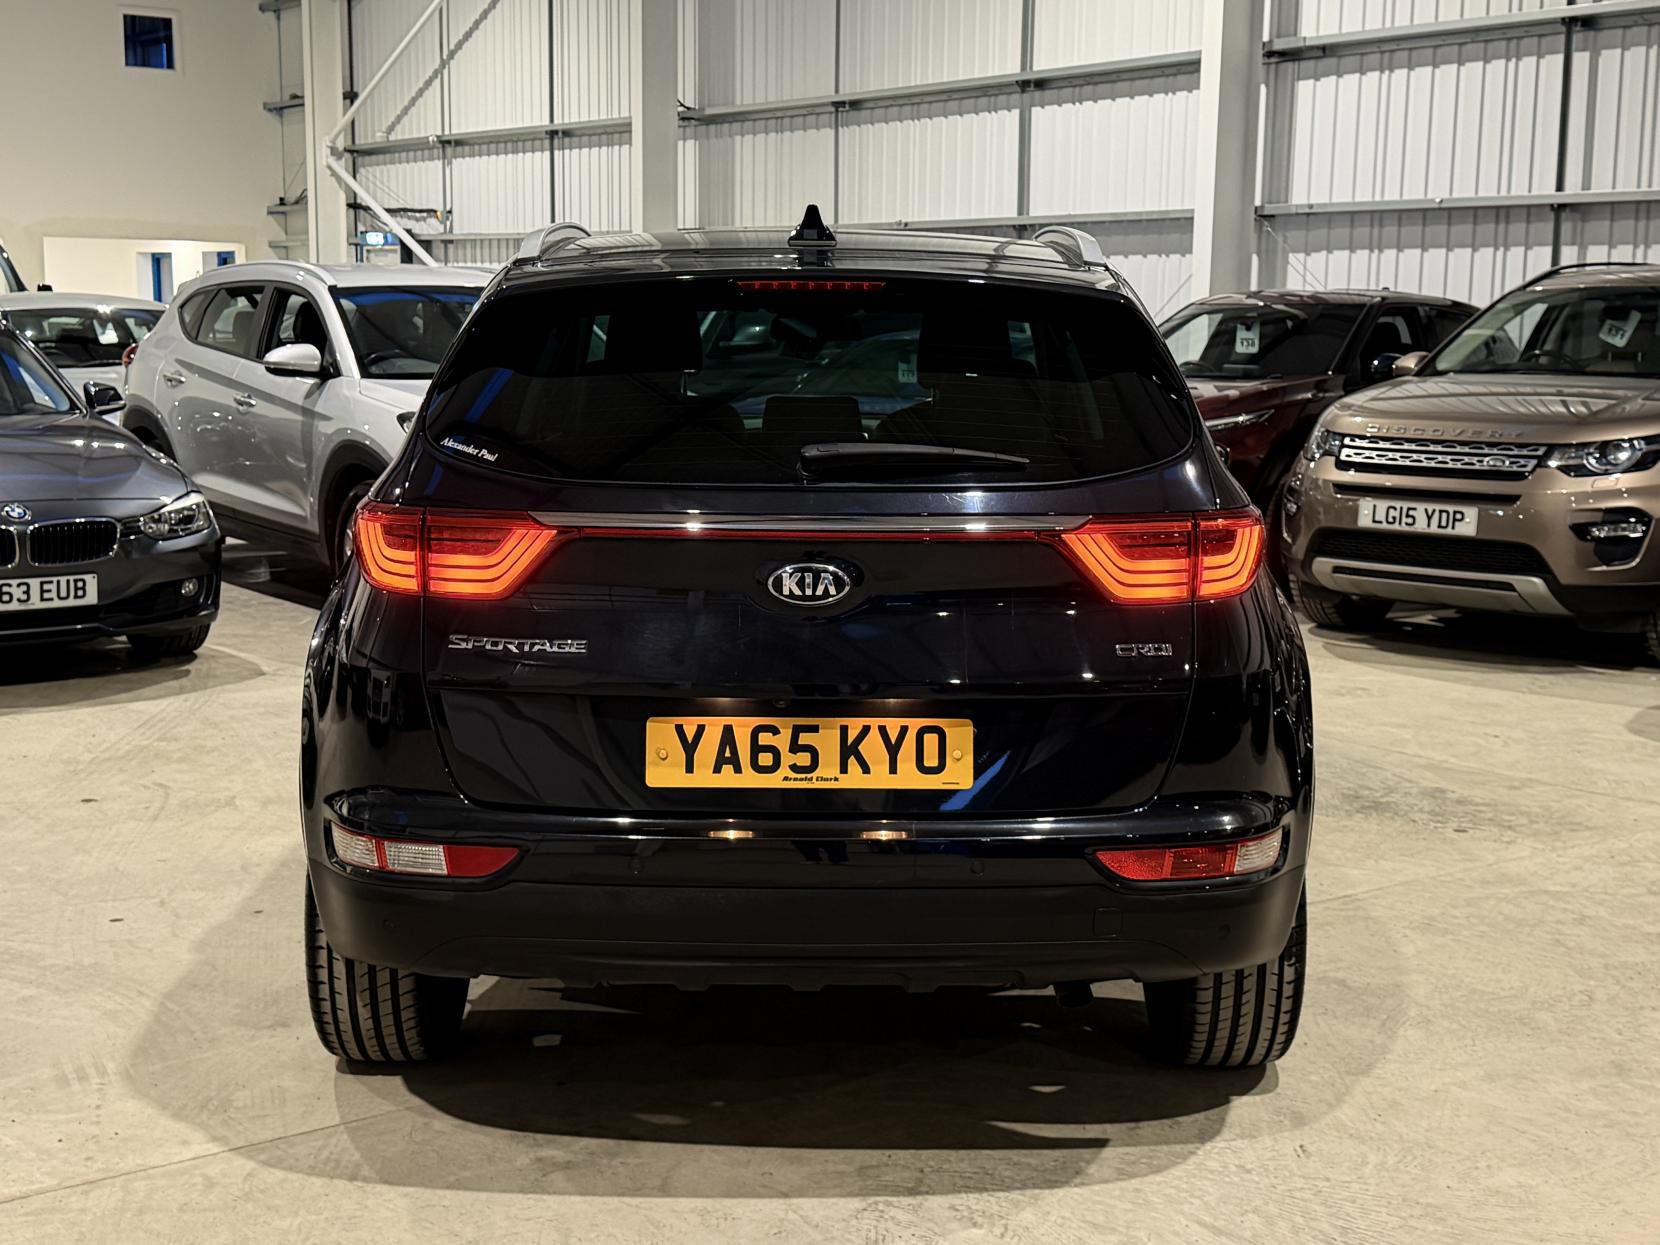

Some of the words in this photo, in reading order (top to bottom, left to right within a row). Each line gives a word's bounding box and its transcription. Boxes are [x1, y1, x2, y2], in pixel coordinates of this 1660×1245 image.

[1366, 423, 1523, 439] DISCOVERY
[440, 437, 479, 455] Alexander
[478, 448, 498, 462] Paul
[1372, 504, 1417, 526] LG15
[1424, 508, 1465, 530] YDP
[40, 578, 87, 602] EUB
[781, 572, 837, 596] KIA
[448, 634, 587, 653] SPORTAGE
[674, 723, 820, 775] YA65
[839, 724, 947, 775] KYO
[782, 775, 814, 783] Arnold
